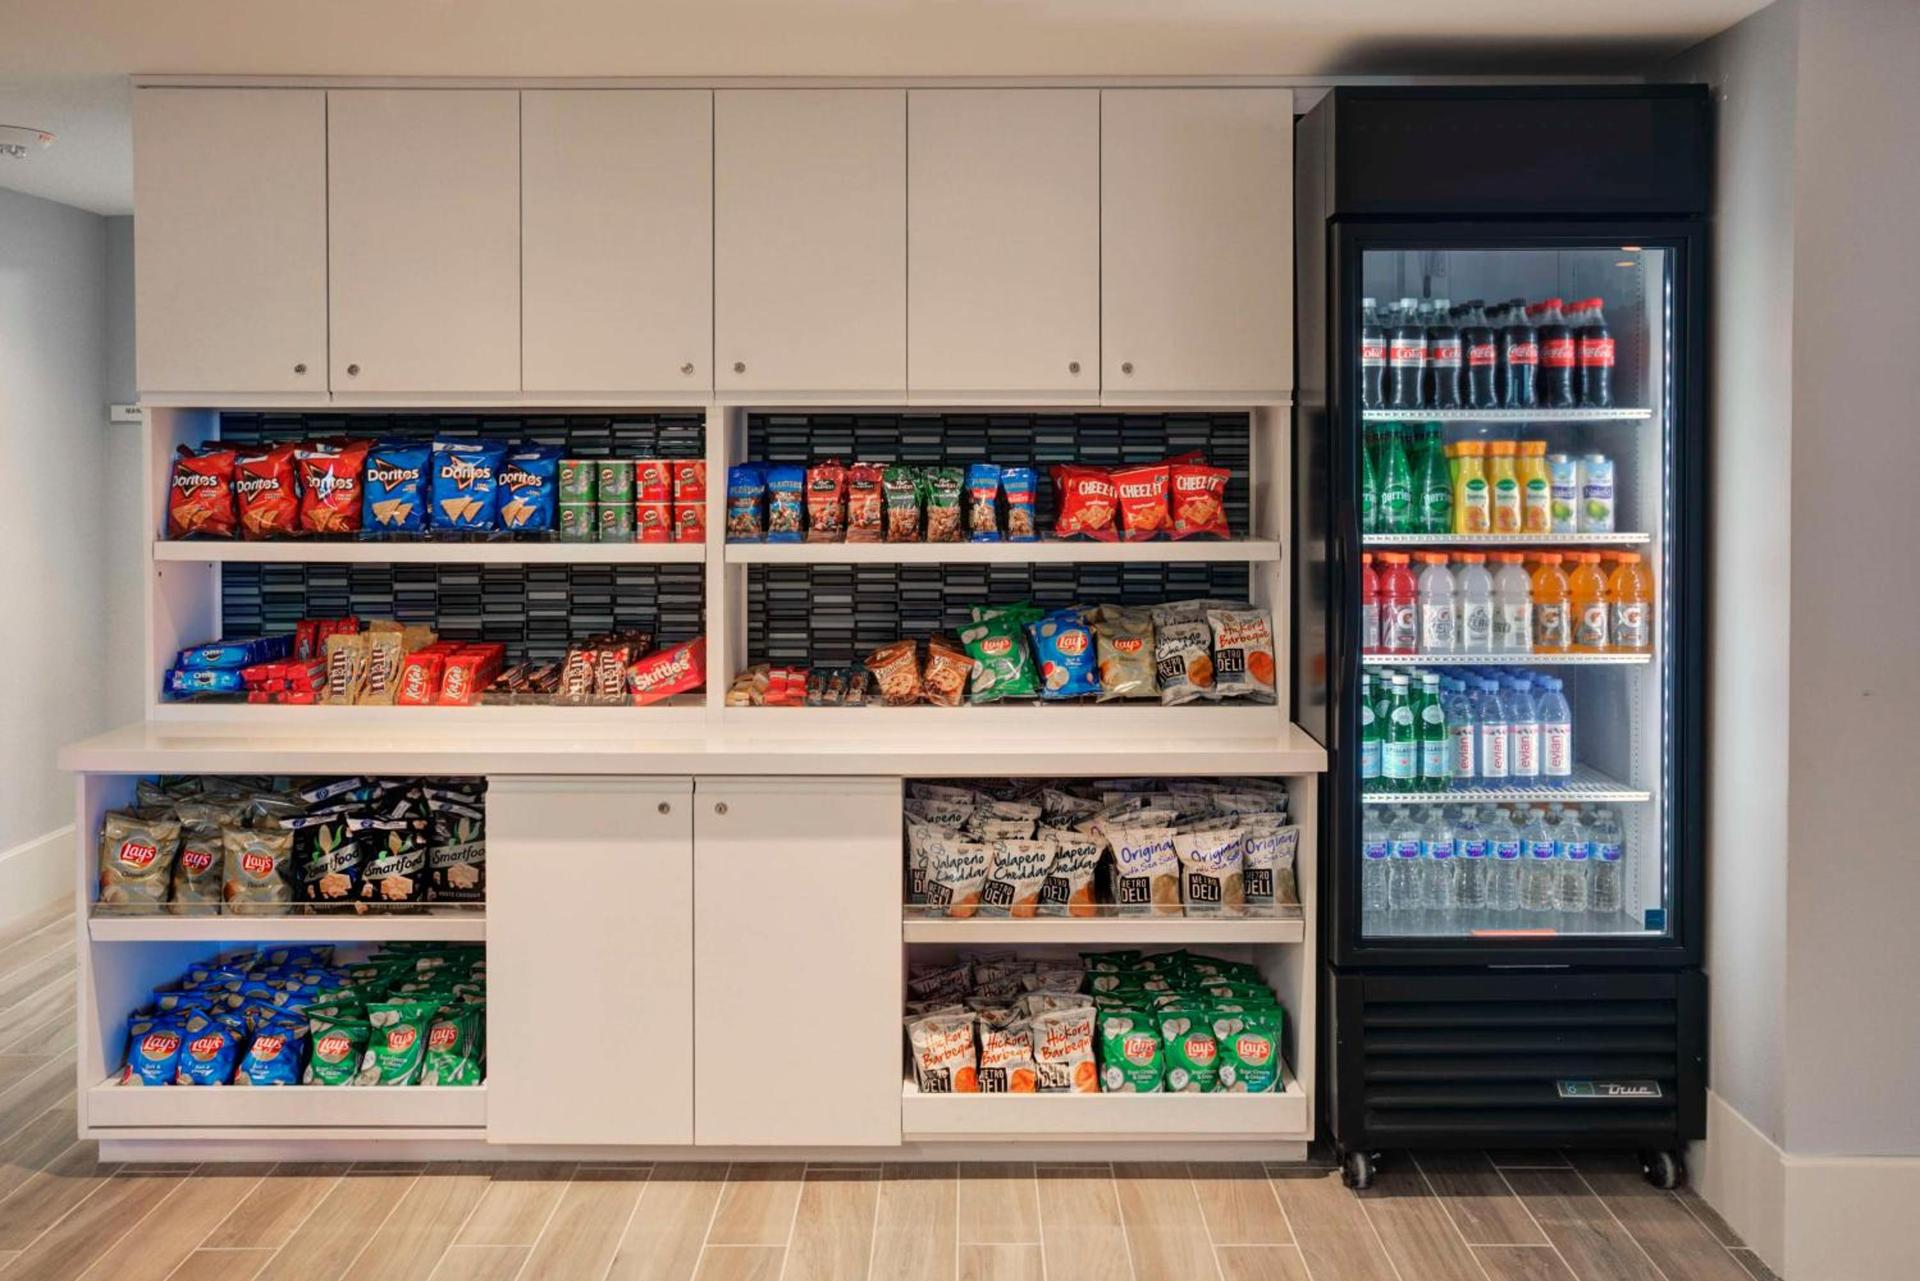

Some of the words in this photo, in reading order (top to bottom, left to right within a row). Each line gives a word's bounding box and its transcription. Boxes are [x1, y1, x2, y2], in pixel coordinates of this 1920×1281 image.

[367, 468, 420, 482] Doritos
[440, 465, 492, 479] Doritos
[498, 473, 543, 487] Doritos
[236, 477, 280, 493] Doritos
[1119, 483, 1162, 499] CHEEZ-IT
[1217, 658, 1243, 672] DELI
[634, 656, 690, 692] Skittles
[1494, 736, 1502, 769] evian
[1520, 735, 1530, 769] evian
[1550, 735, 1561, 768] evian
[184, 850, 211, 868] ay's
[432, 847, 486, 864] Smartfoo
[1121, 887, 1148, 902] DELI
[1192, 883, 1219, 901] DELI
[1245, 879, 1272, 896] DELI
[987, 1030, 1030, 1050] Hickory
[1046, 1020, 1091, 1046] Hickory
